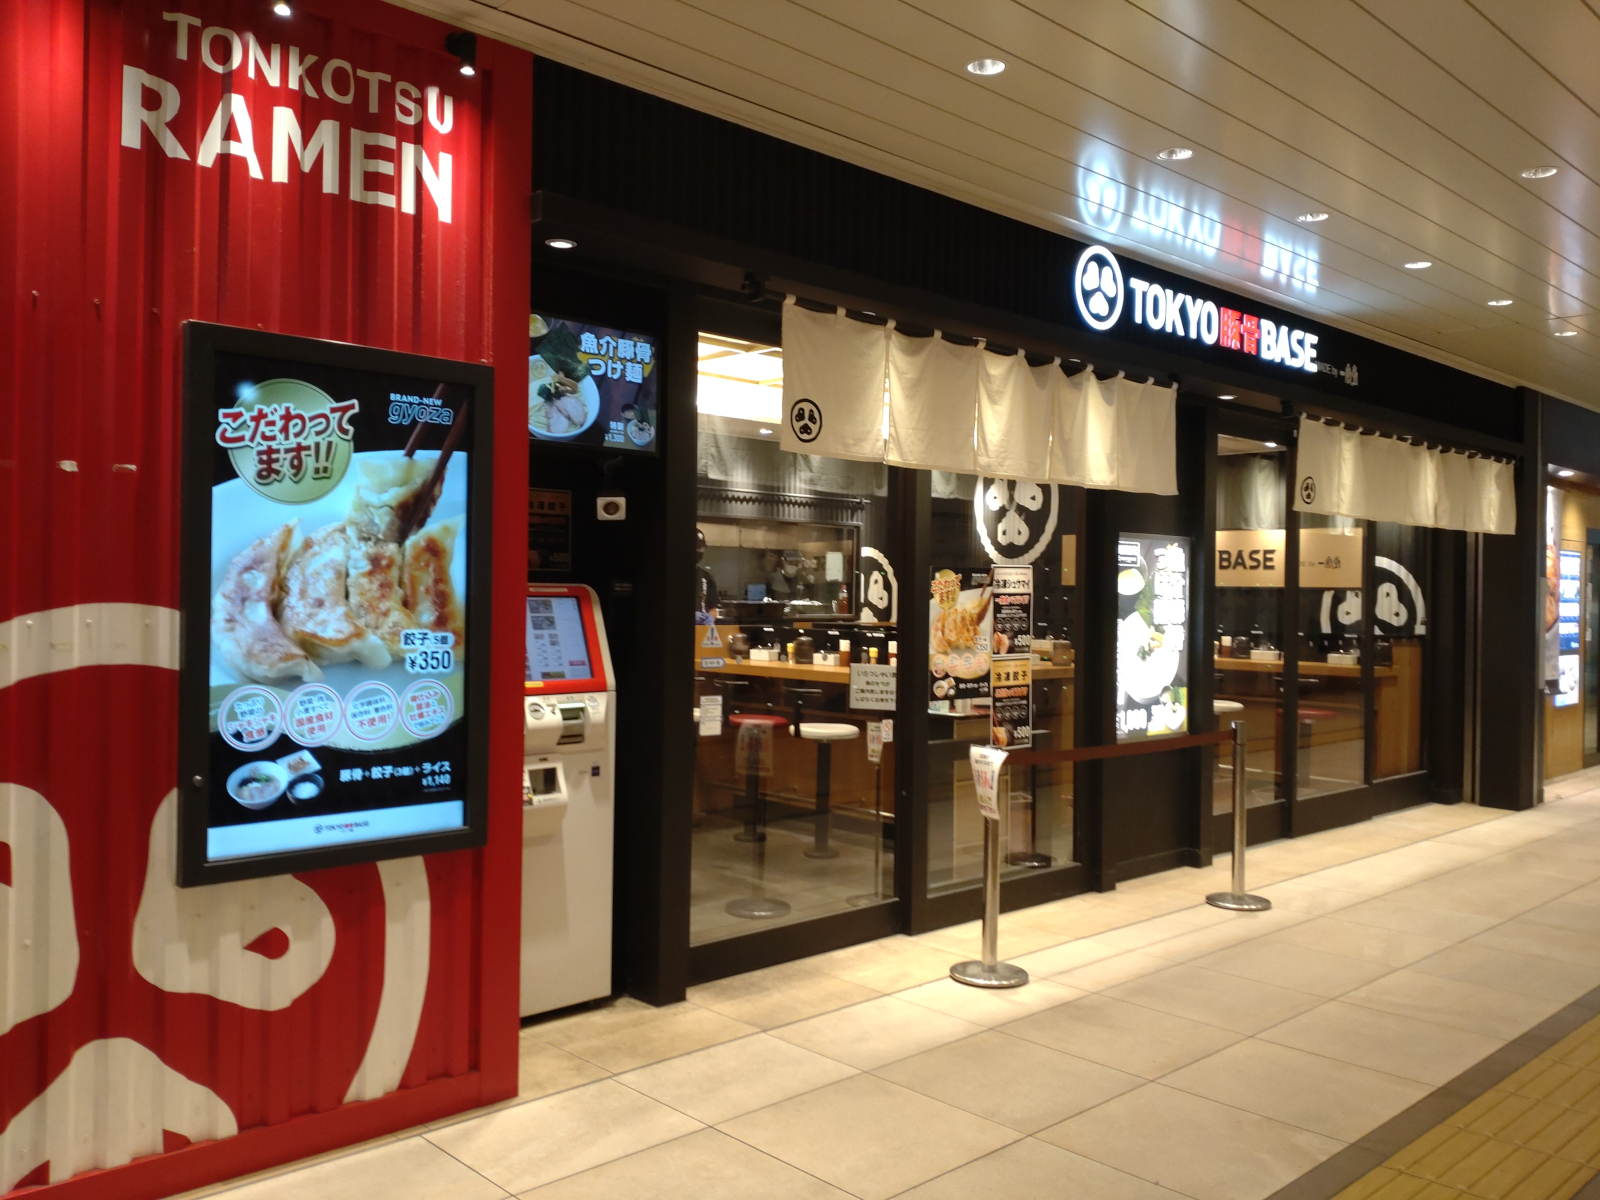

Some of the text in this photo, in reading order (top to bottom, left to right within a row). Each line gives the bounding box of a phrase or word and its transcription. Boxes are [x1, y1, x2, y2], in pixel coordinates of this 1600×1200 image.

[162, 12, 454, 135] TONKOTSU
[121, 64, 453, 224] RAMEN
[580, 332, 652, 363] 魚介豚骨
[588, 359, 643, 383] つけ麺
[389, 393, 443, 406] BRAND-NEW
[217, 400, 358, 447] こだわって
[388, 402, 454, 425] gyoza
[1218, 549, 1276, 570] BASE
[408, 650, 451, 670] ¥350
